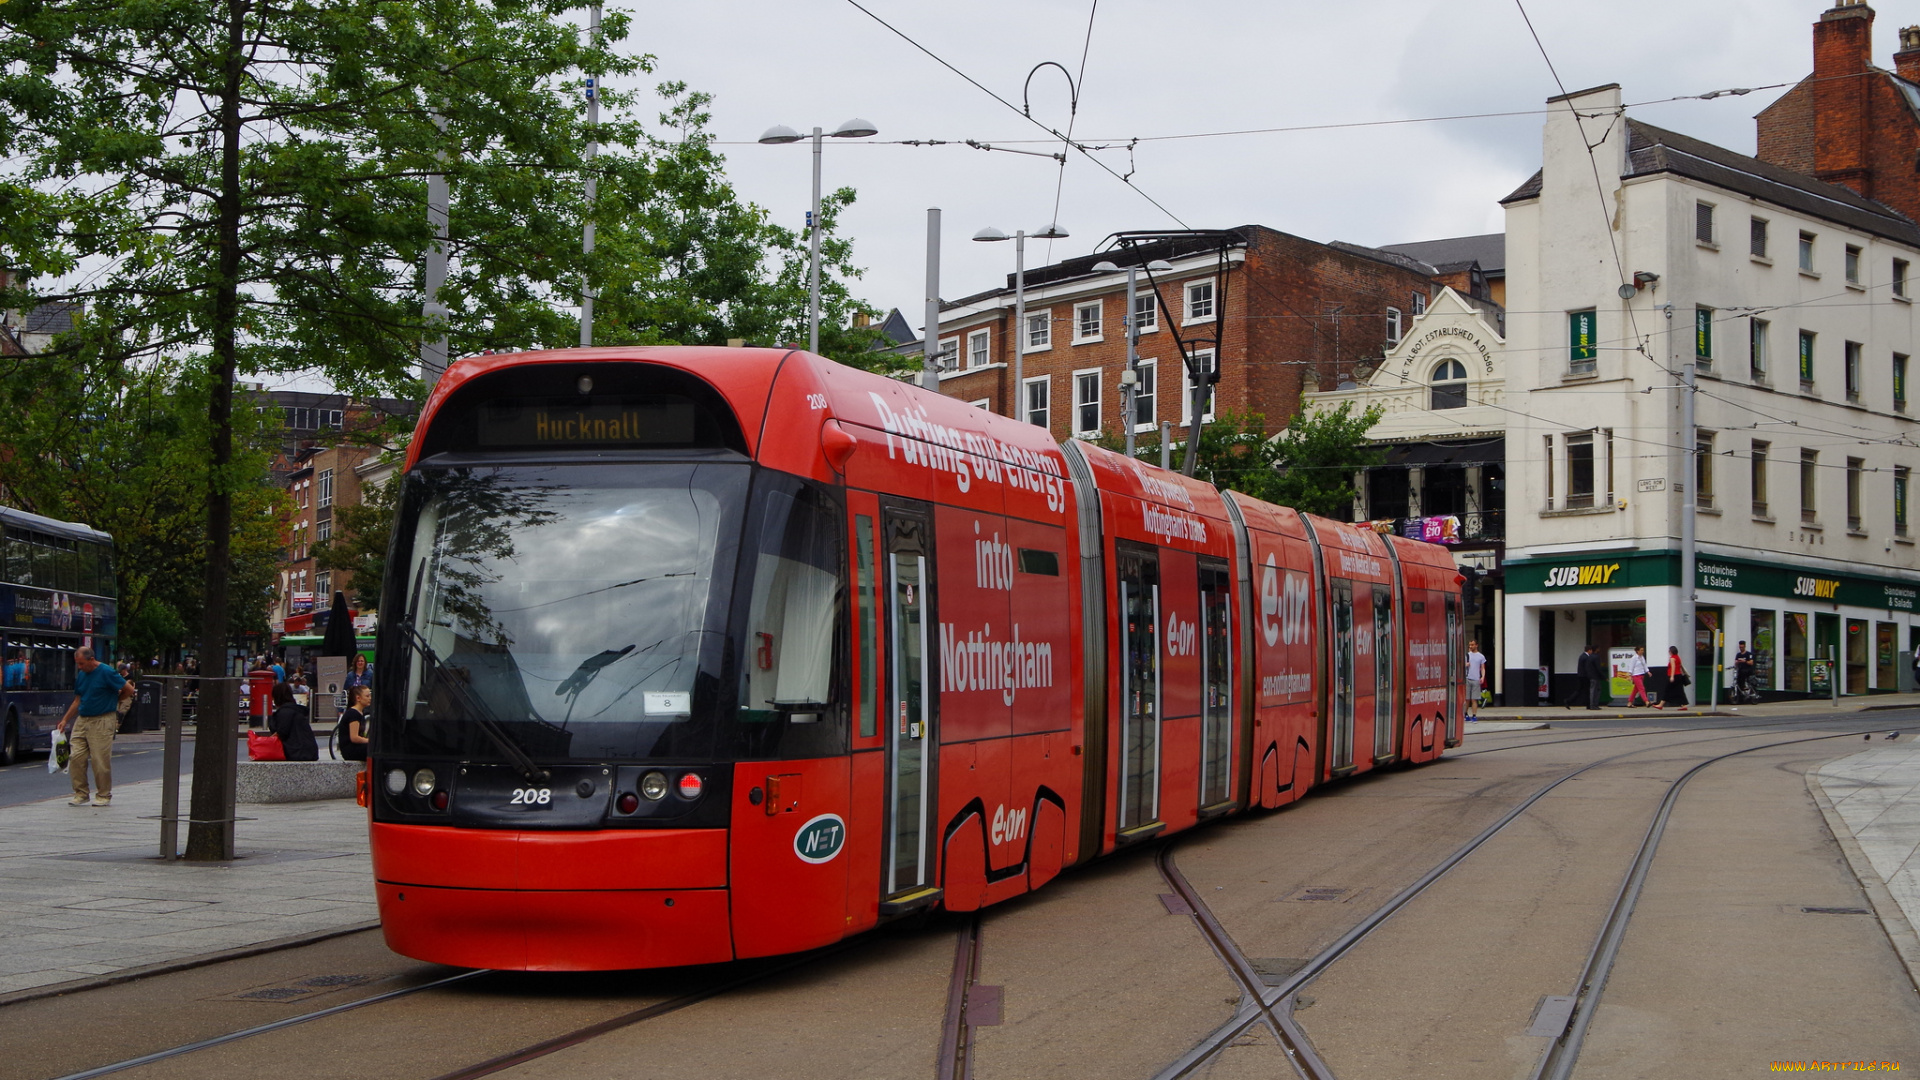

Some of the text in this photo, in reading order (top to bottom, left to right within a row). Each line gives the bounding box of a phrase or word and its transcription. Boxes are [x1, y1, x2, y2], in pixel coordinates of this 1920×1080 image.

[1580, 314, 1588, 357] SUBWAY
[1400, 369, 1410, 384] THE
[1425, 327, 1474, 343] ESTABLISHED
[807, 393, 828, 410] 208
[536, 411, 641, 440] Hucknall
[868, 391, 1065, 514] Putting our energy
[1187, 515, 1207, 543] trams
[1425, 526, 1441, 538] £10
[974, 519, 1014, 591] into
[1544, 562, 1620, 588] SUBWAY
[1698, 562, 1738, 577] Sandwiches
[1703, 575, 1733, 588] & Salads
[1793, 576, 1840, 598] SUBWAY
[939, 622, 1052, 706] Nottingham
[664, 699, 671, 707] 8
[510, 788, 551, 805] 208
[804, 825, 839, 853] NET
